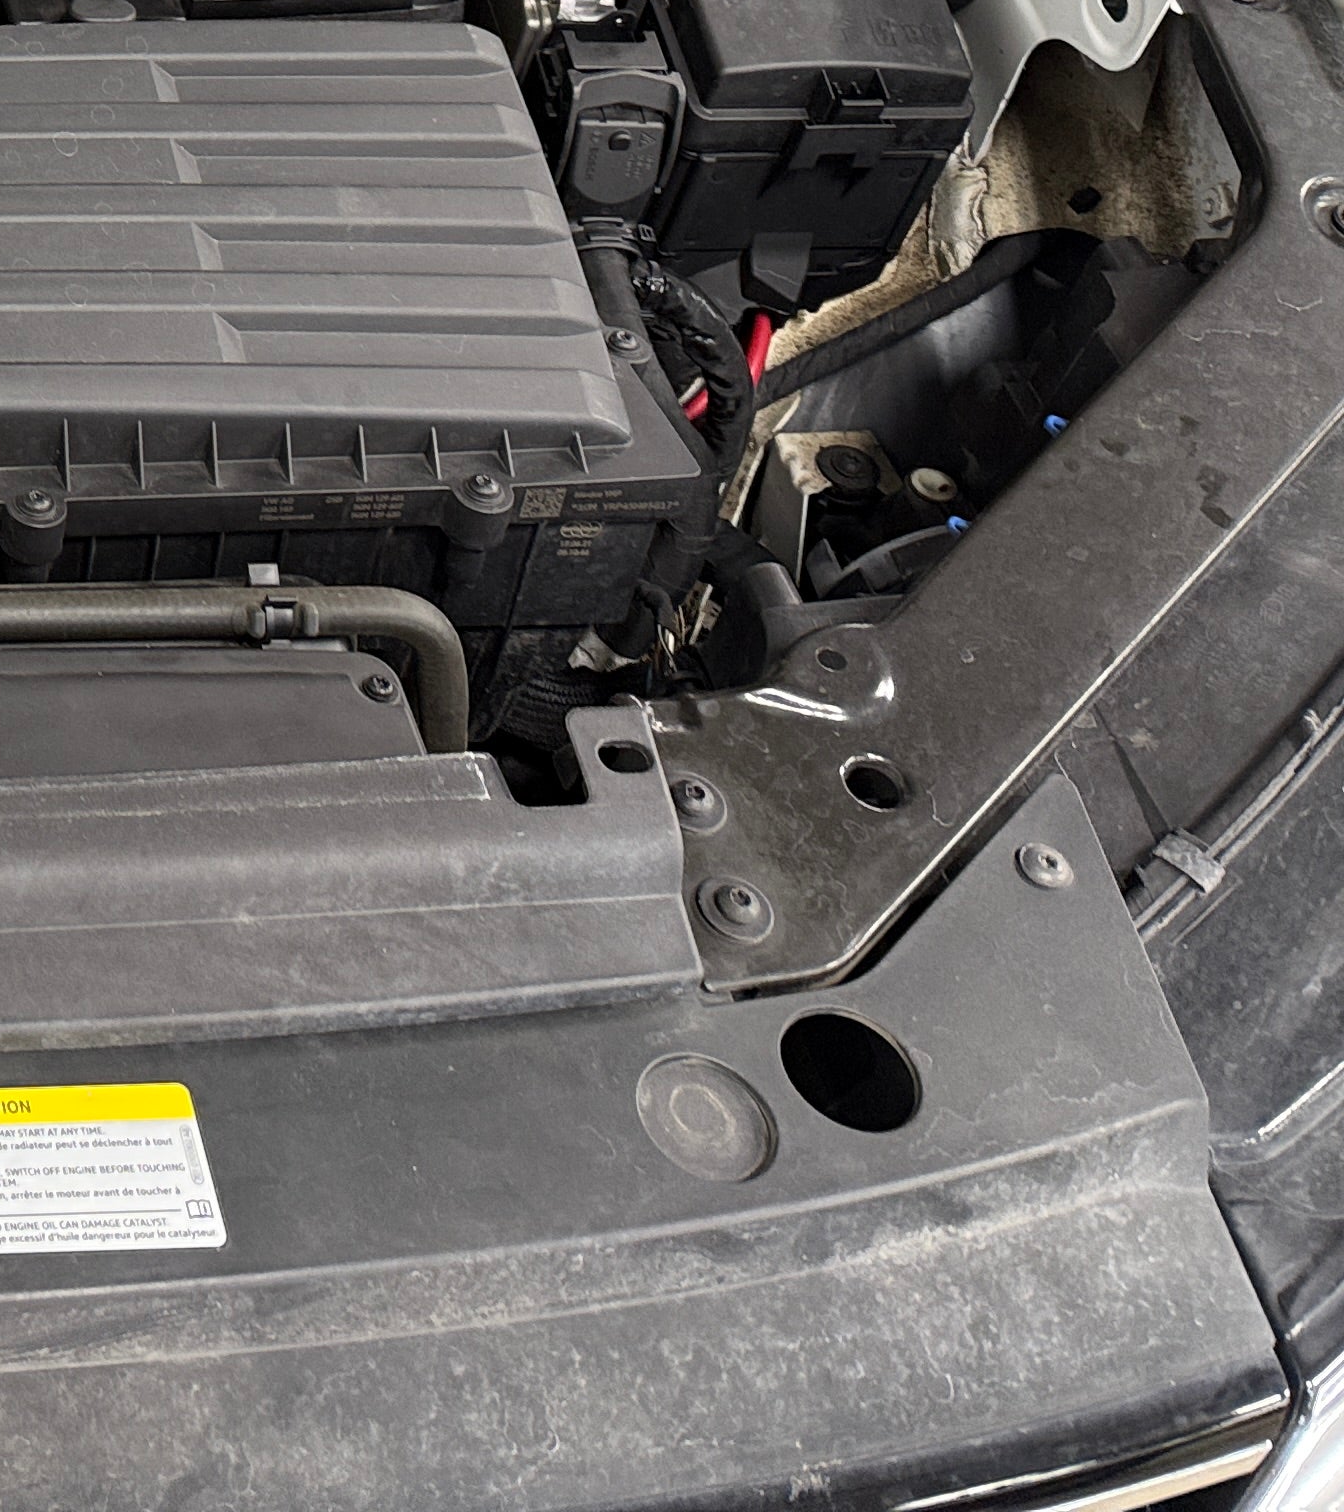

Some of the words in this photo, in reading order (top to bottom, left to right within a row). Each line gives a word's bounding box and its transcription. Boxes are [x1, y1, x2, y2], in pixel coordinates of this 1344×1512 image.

[17, 1128, 45, 1138] START
[47, 1127, 58, 1137] AT
[60, 1127, 79, 1136] ANY
[79, 1126, 105, 1136] TIME.
[10, 1139, 53, 1150] radiateur
[55, 1139, 77, 1151] peut
[79, 1141, 90, 1149] se
[91, 1137, 143, 1149] déclencher
[144, 1137, 151, 1147] à
[152, 1137, 173, 1147] tout
[4, 1167, 41, 1177] SWITCH
[42, 1166, 60, 1176] OFF
[62, 1165, 97, 1175] ENGINE
[99, 1164, 136, 1174] BEFORE
[137, 1162, 186, 1173] TOUCHING
[10, 1190, 43, 1200] arrêter
[45, 1189, 54, 1199] le
[56, 1189, 92, 1198] moteur
[93, 1187, 121, 1197] avant
[122, 1187, 134, 1196] de
[135, 1185, 173, 1196] toucher
[175, 1185, 181, 1195] à
[4, 1221, 40, 1231] ENGINE
[42, 1220, 58, 1230] OIL
[59, 1219, 79, 1229] CAN
[81, 1218, 122, 1228] DAMAGE
[8, 1232, 46, 1242] excessif
[47, 1231, 80, 1241] d'huile
[81, 1230, 132, 1242] dangereux
[133, 1230, 155, 1240] pour
[156, 1228, 166, 1238] le
